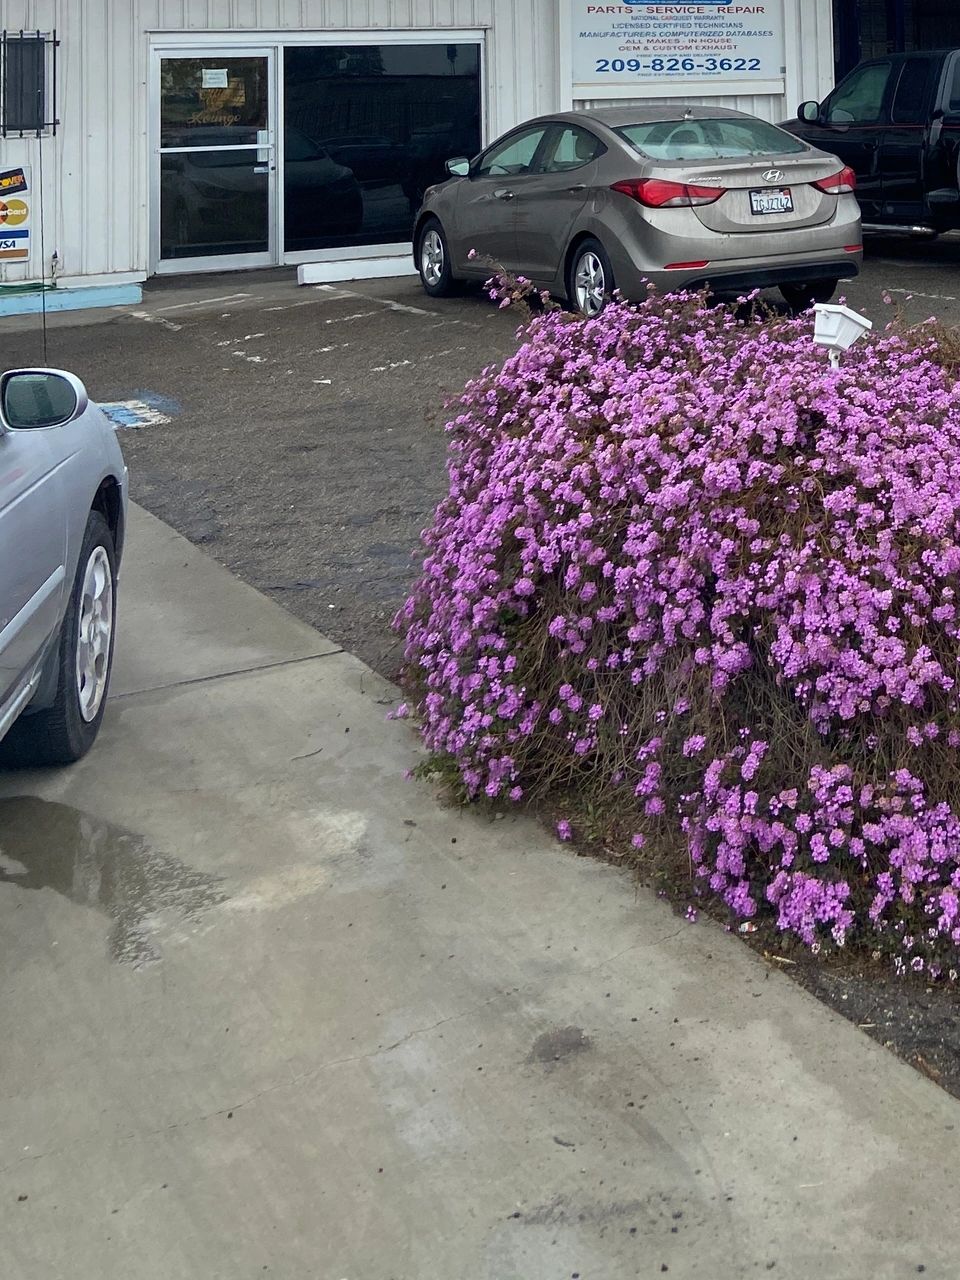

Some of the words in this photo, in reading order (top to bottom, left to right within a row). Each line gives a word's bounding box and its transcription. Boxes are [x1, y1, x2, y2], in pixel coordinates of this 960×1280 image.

[587, 6, 634, 14] PARTS
[646, 6, 705, 14] SERVICE
[718, 6, 765, 14] REPAIR
[595, 58, 761, 72] 209-826-3622
[0, 175, 24, 187] OVER
